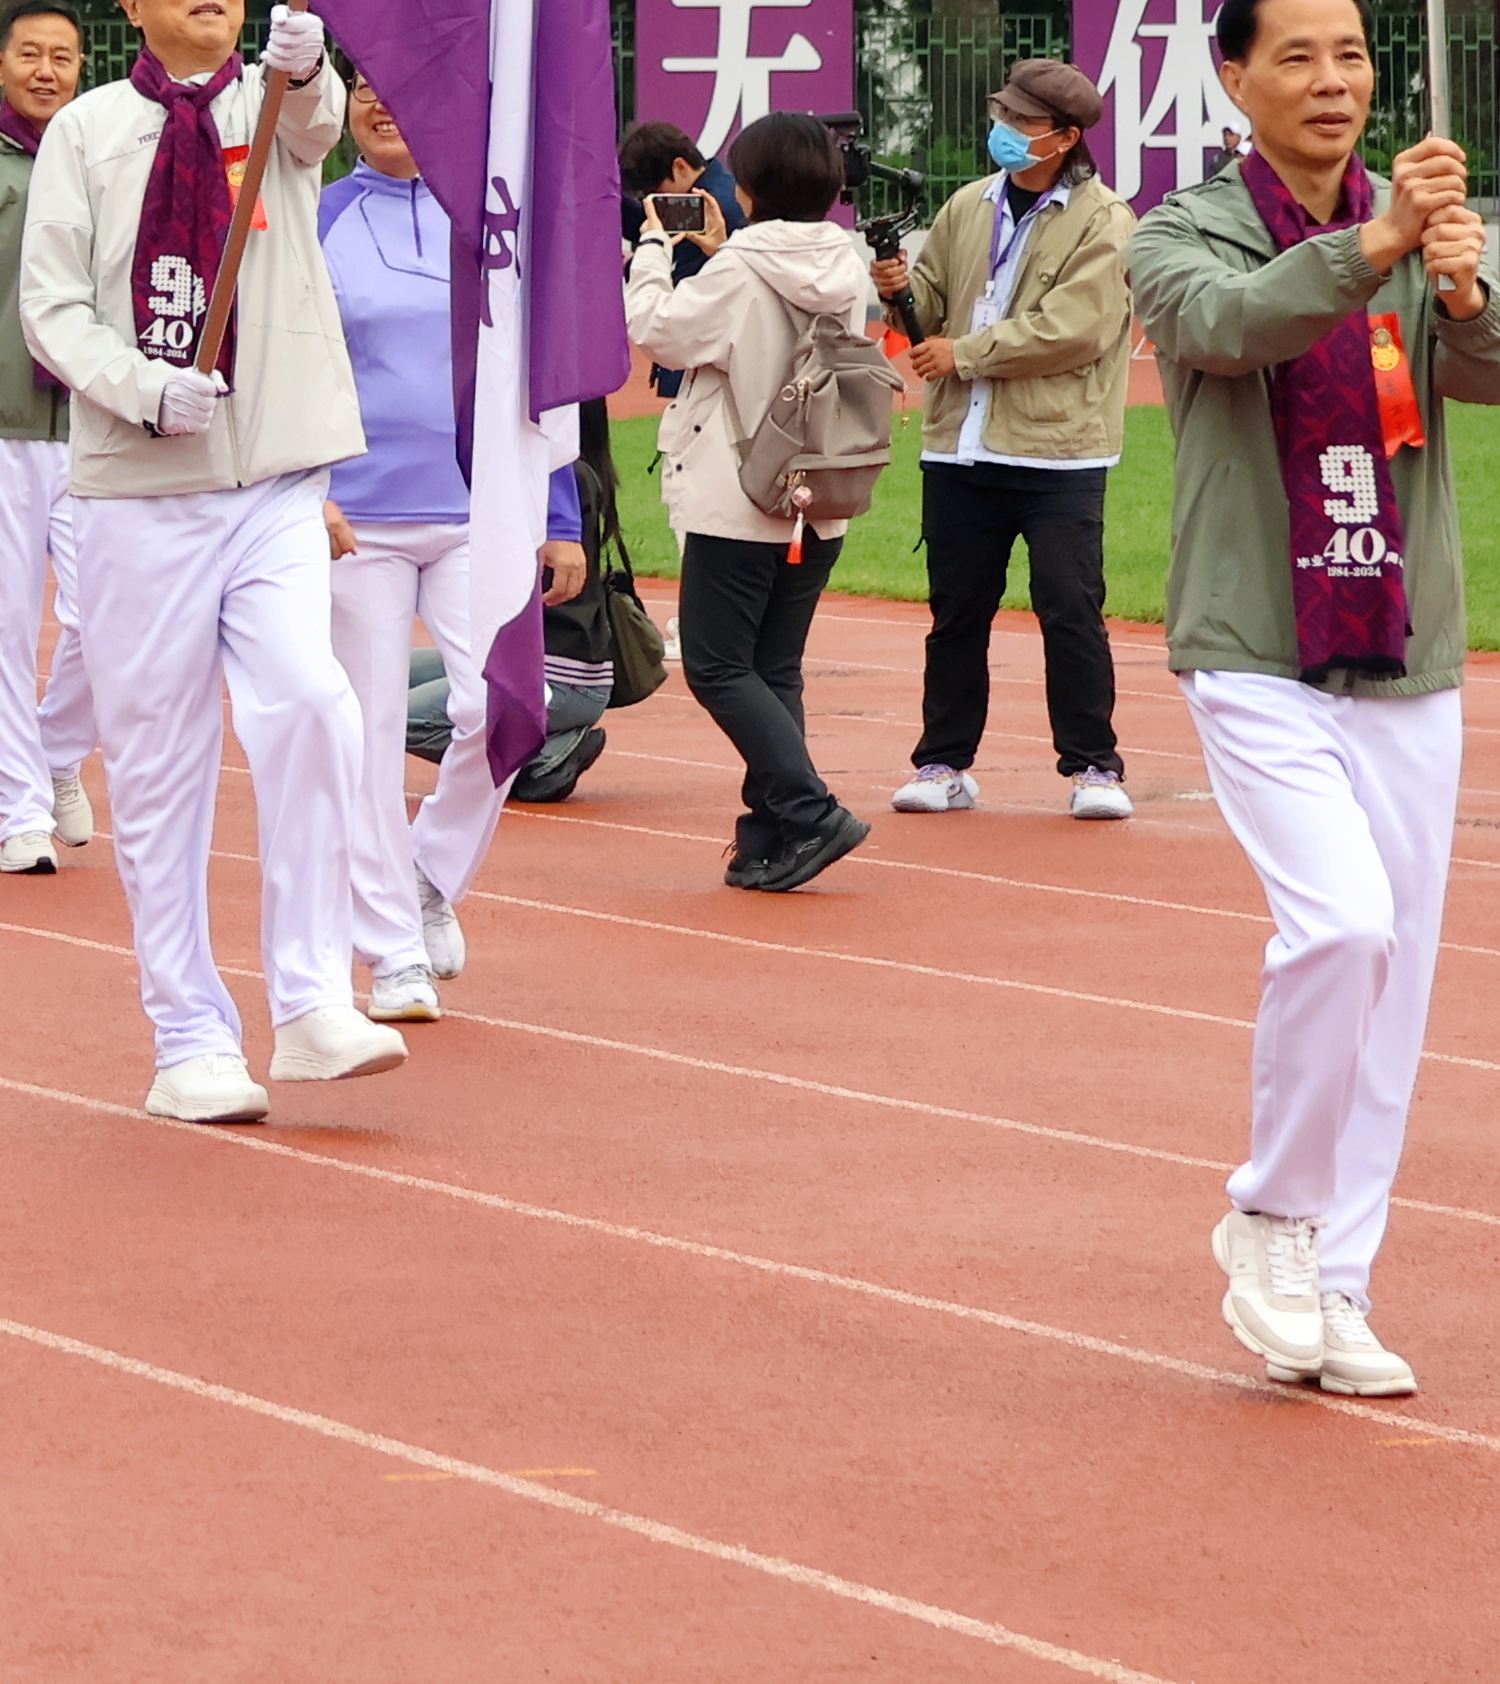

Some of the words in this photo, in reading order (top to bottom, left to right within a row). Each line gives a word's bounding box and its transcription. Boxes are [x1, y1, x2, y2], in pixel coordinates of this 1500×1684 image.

[148, 254, 193, 317] 9
[139, 317, 194, 350] 40
[1318, 444, 1379, 524] 9
[1323, 527, 1387, 565] 40
